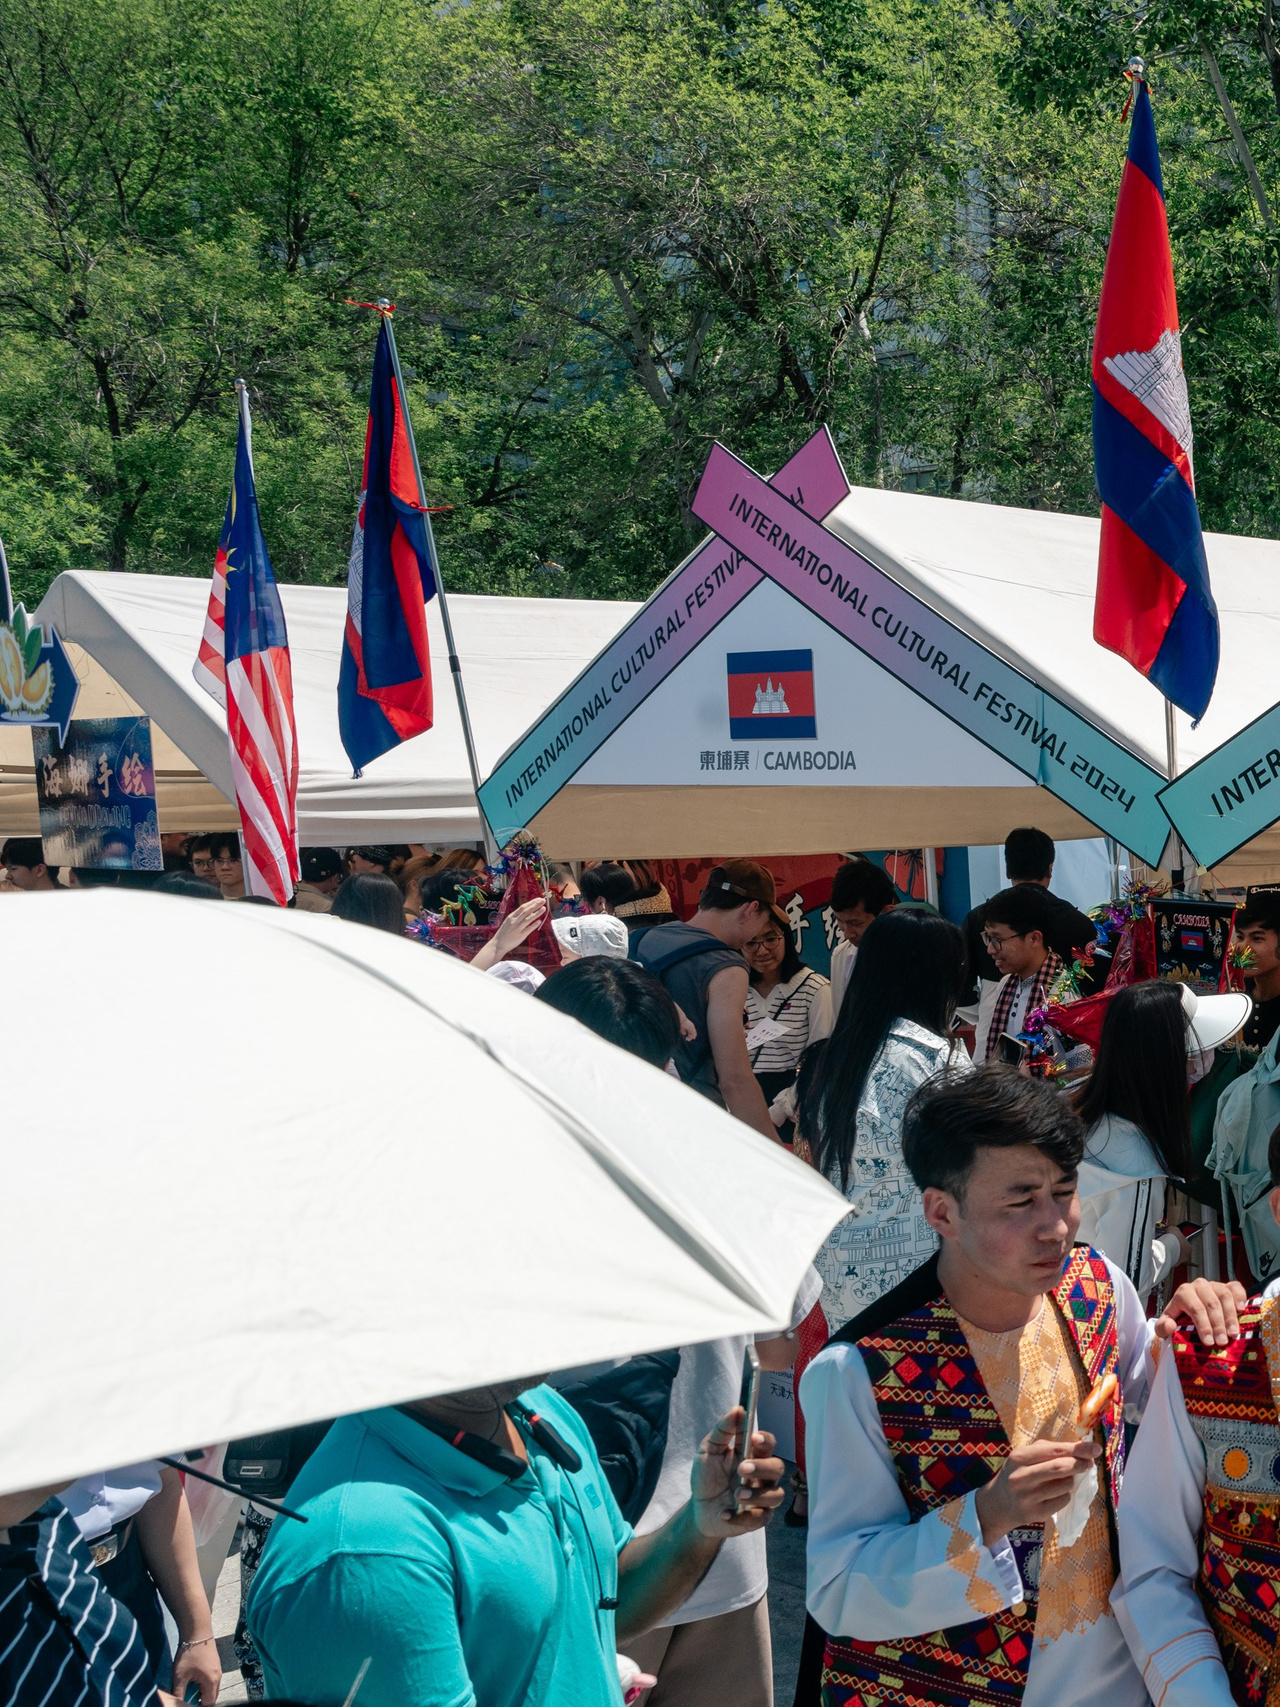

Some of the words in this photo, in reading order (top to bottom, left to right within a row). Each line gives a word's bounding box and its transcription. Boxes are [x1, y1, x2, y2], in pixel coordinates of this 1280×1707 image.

[505, 686, 612, 808] INTERNATIONAL
[610, 609, 686, 692] CULTURAL
[685, 551, 748, 618] FESTIVA
[729, 493, 867, 617] INTERNATIONAL
[871, 606, 970, 695] CULTURAL
[973, 682, 1067, 764] FESTIVAL
[1070, 754, 1137, 814] 2024
[700, 750, 749, 771] 柬埔寨
[763, 750, 857, 771] CAMBODIA
[1173, 913, 1211, 928] CAMBODIA
